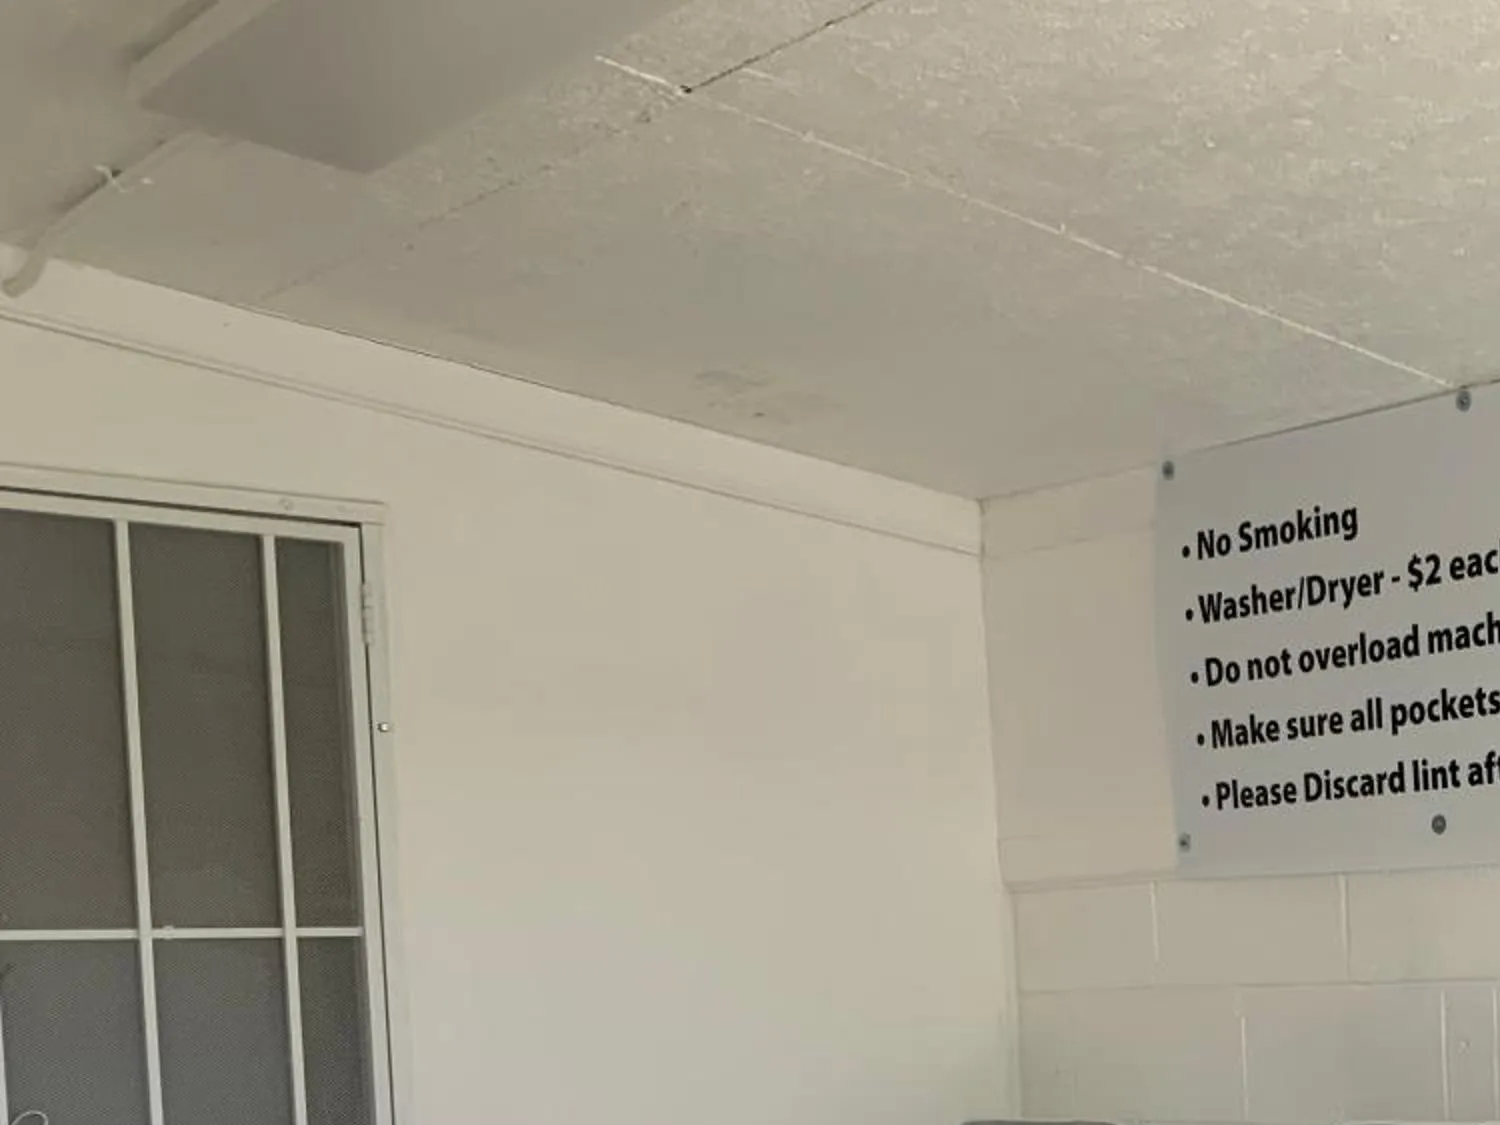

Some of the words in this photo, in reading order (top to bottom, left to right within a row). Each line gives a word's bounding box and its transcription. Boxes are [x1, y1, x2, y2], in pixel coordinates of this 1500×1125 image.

[1196, 528, 1233, 561] No
[1237, 504, 1359, 554] Smoking
[1197, 569, 1385, 625] Washer/Dryer
[1407, 552, 1443, 593] $2
[1203, 656, 1241, 688] Do
[1246, 647, 1293, 682] not
[1297, 623, 1421, 674] overload
[1210, 713, 1281, 750] Make
[1285, 711, 1345, 741] sure
[1349, 696, 1384, 733] all
[1215, 778, 1298, 812] Please
[1303, 760, 1407, 803] Discard
[1411, 757, 1462, 793] lint
